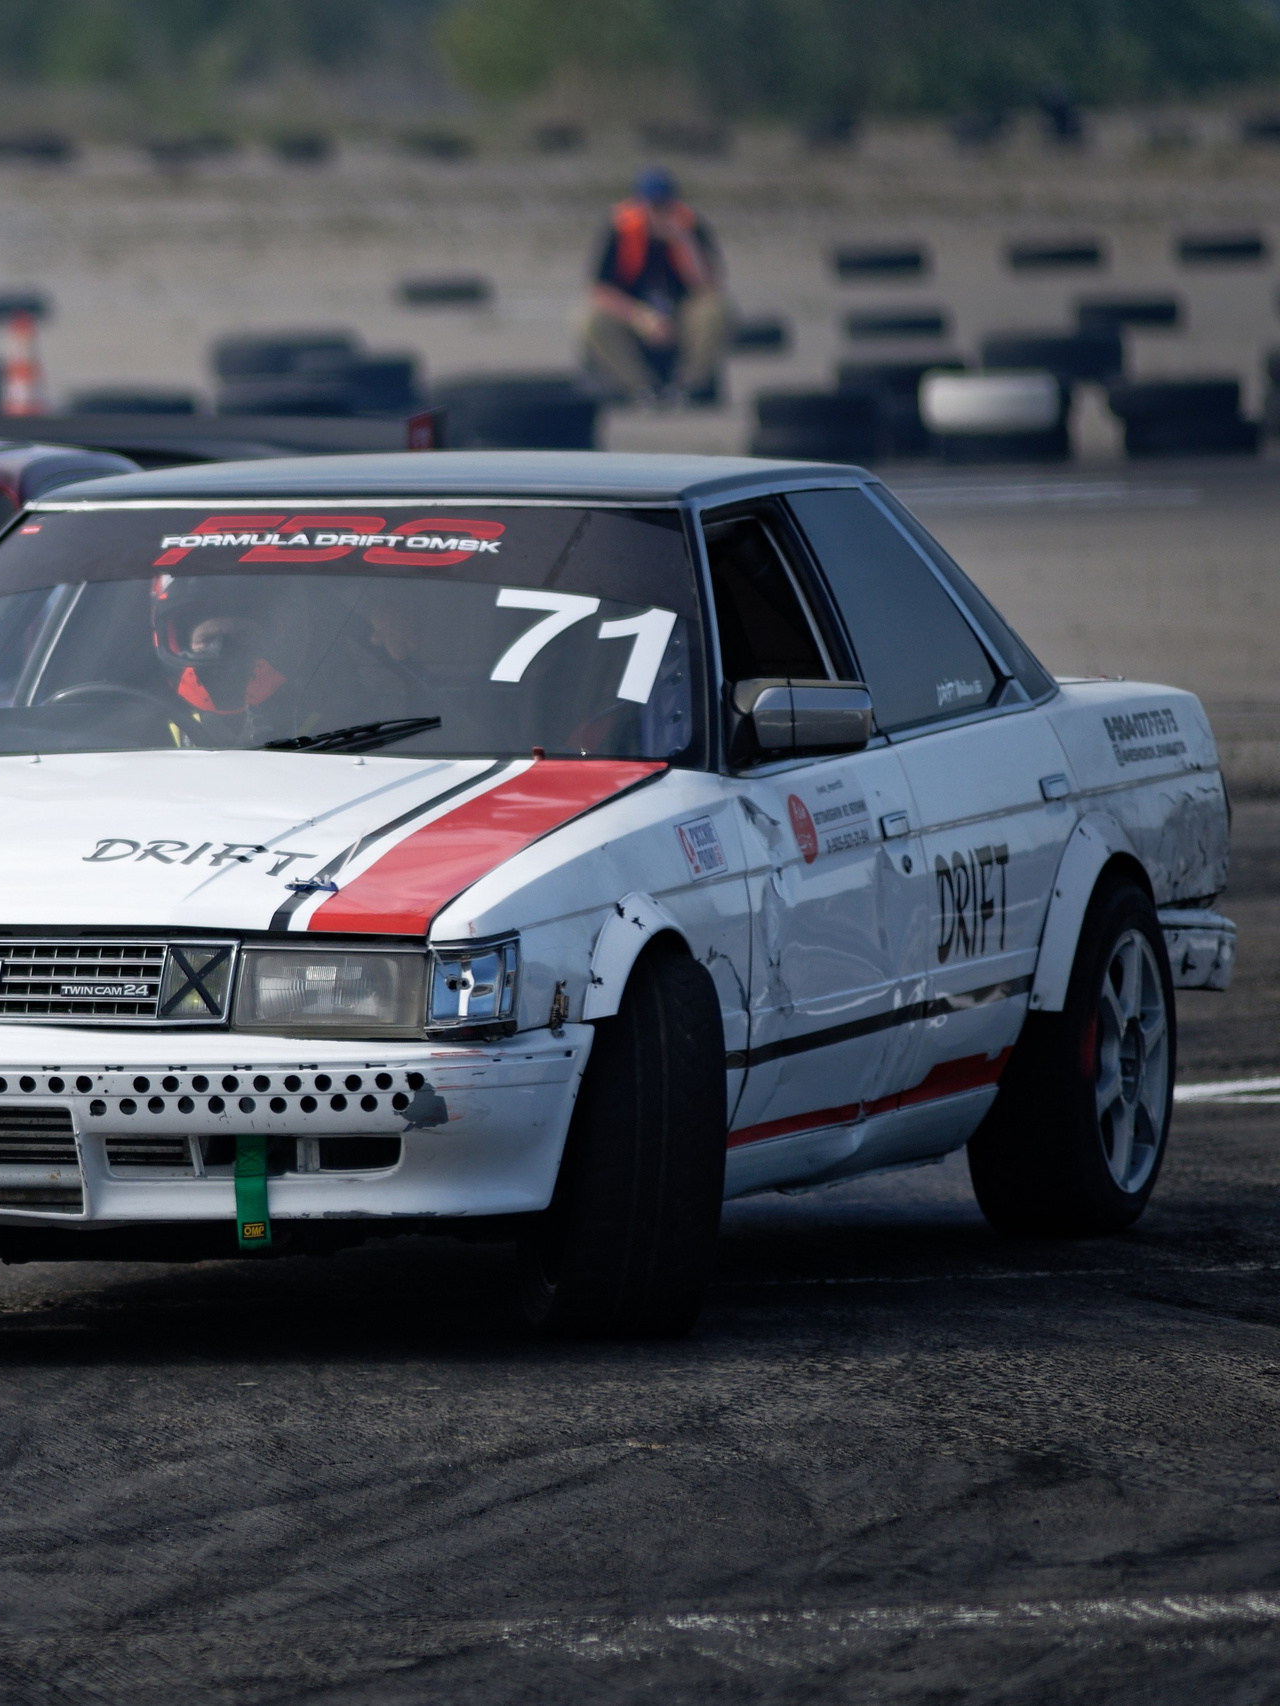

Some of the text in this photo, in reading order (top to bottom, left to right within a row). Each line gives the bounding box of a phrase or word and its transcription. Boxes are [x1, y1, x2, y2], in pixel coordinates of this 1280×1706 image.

[161, 533, 502, 553] FORMULA DRIFT OMSK
[490, 587, 678, 704] 71
[82, 838, 318, 877] DRIFT
[935, 844, 1009, 964] DRIFT
[61, 984, 149, 997] TWIN CAM 24
[243, 1226, 264, 1236] OMP
